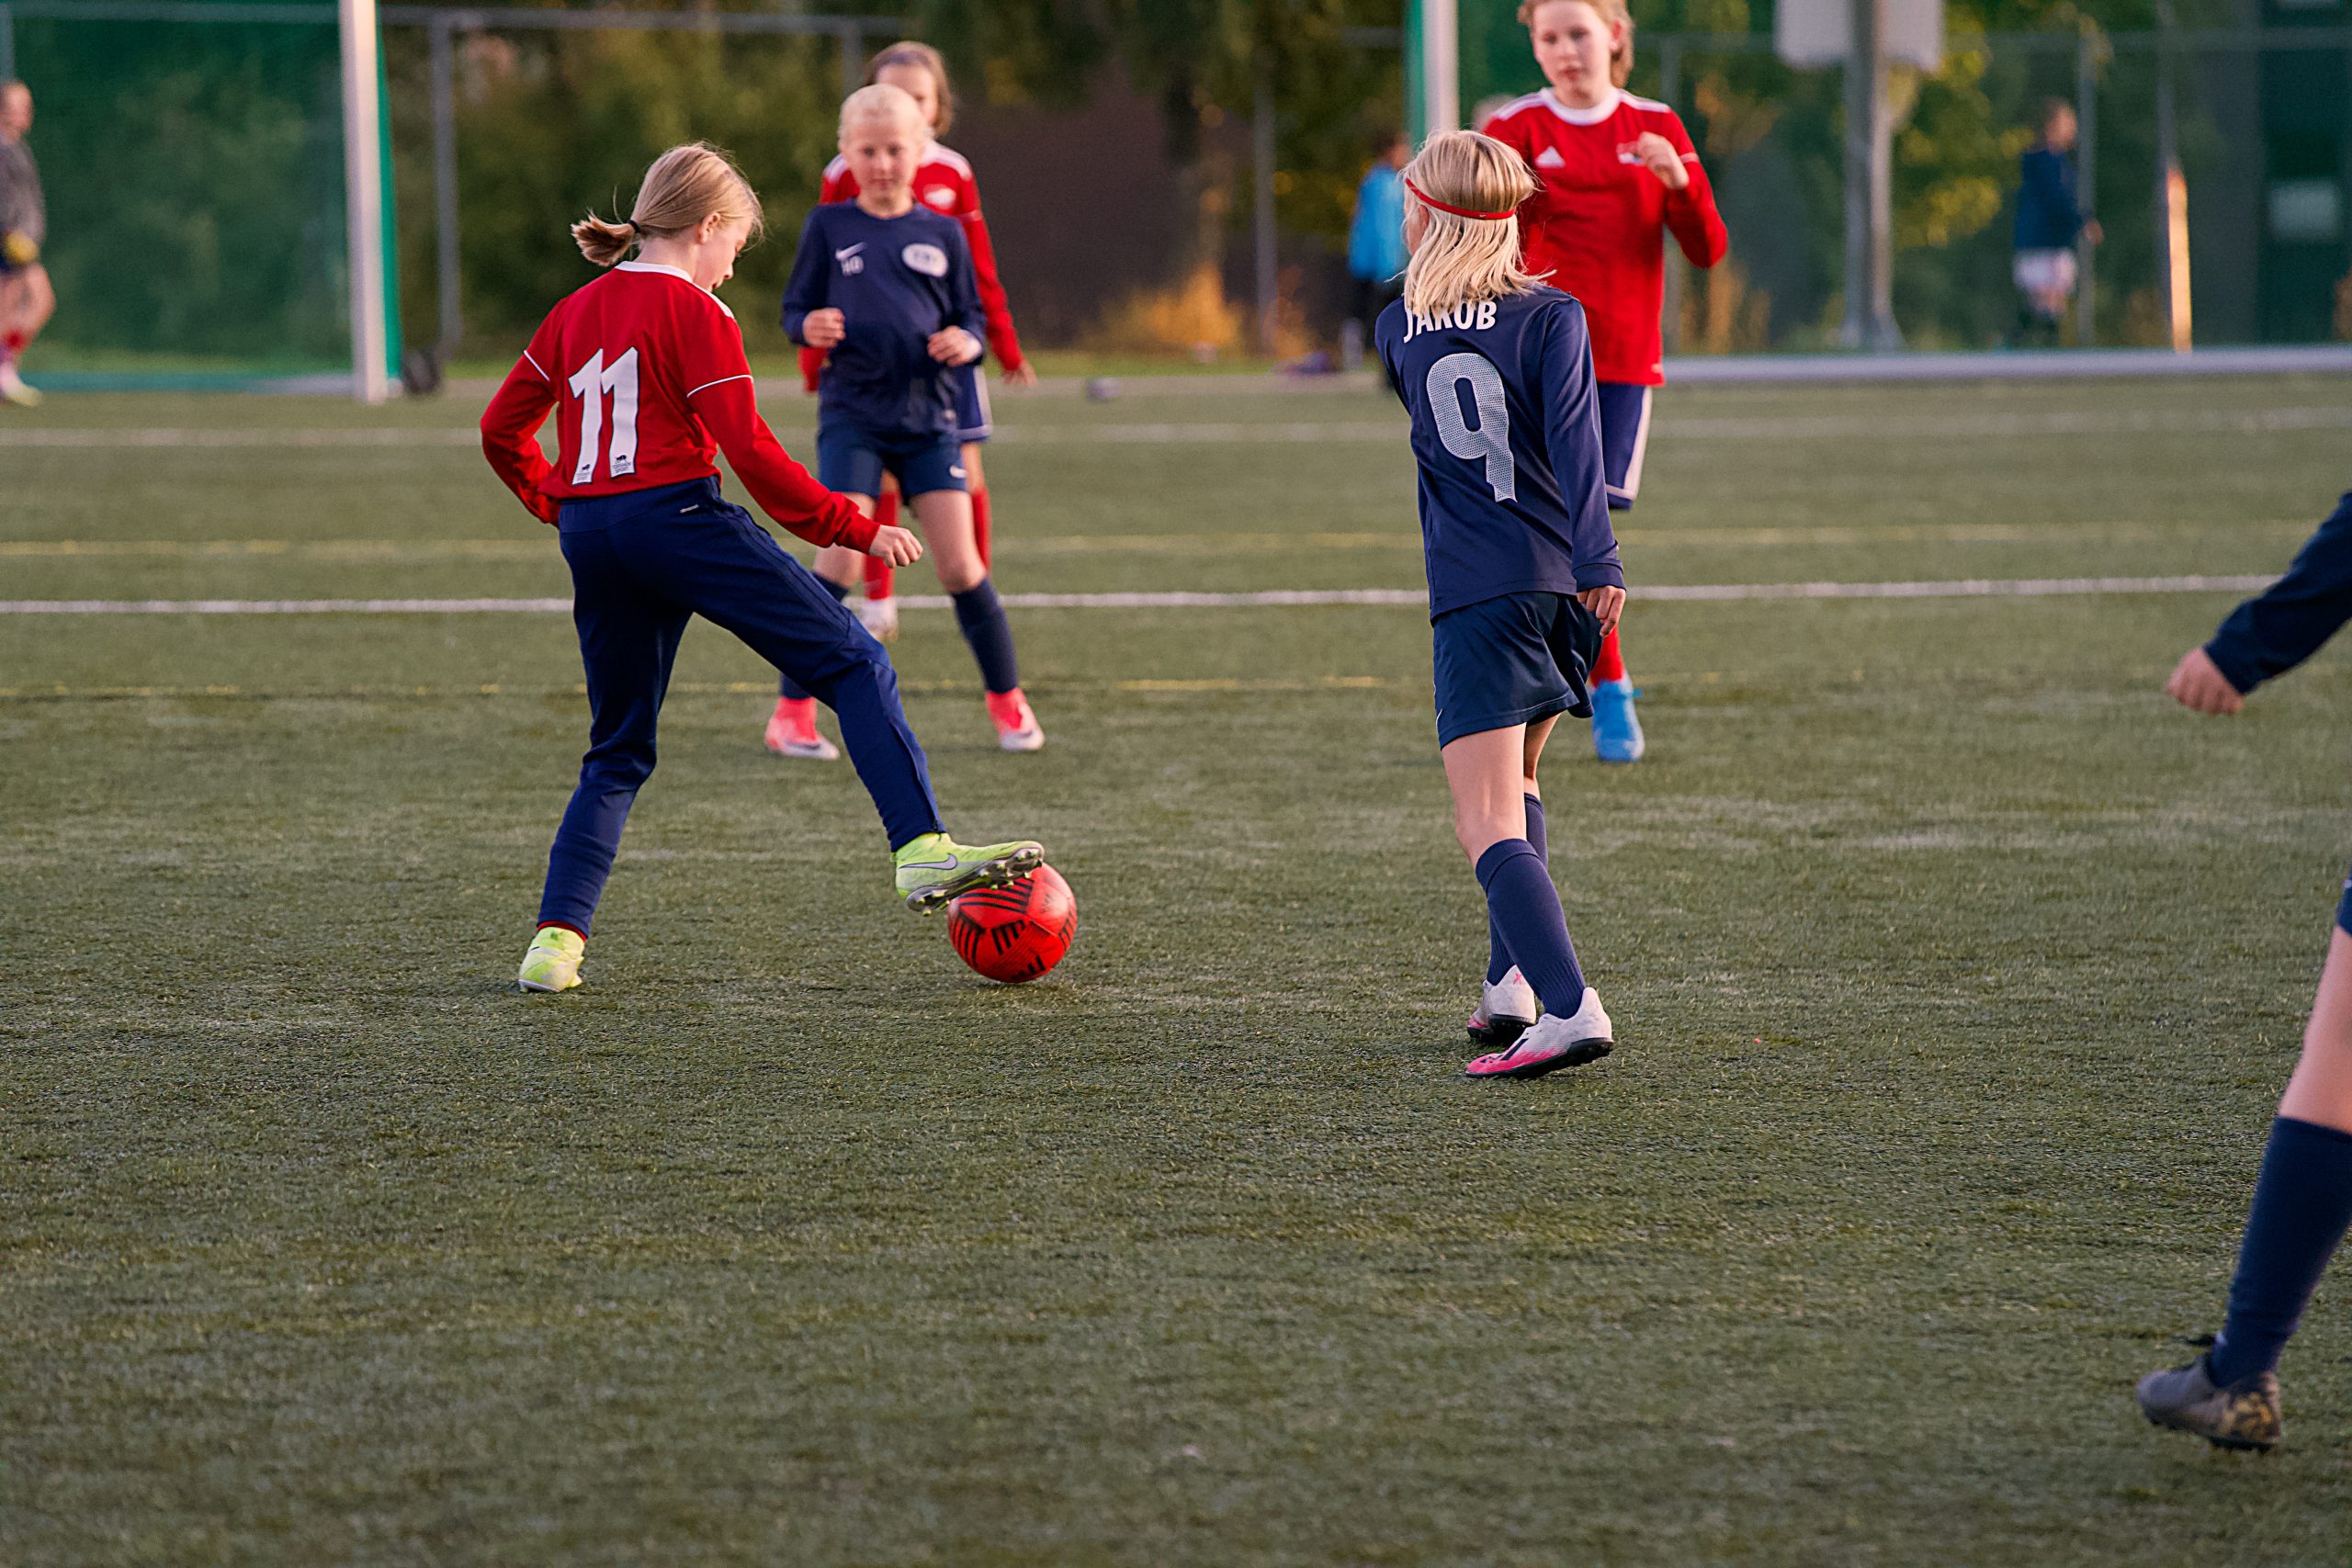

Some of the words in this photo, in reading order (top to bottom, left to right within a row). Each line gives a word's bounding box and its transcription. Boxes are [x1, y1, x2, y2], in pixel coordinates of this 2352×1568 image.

[1403, 300, 1498, 343] JAKOB
[568, 346, 639, 486] 11
[1426, 352, 1517, 502] 9
